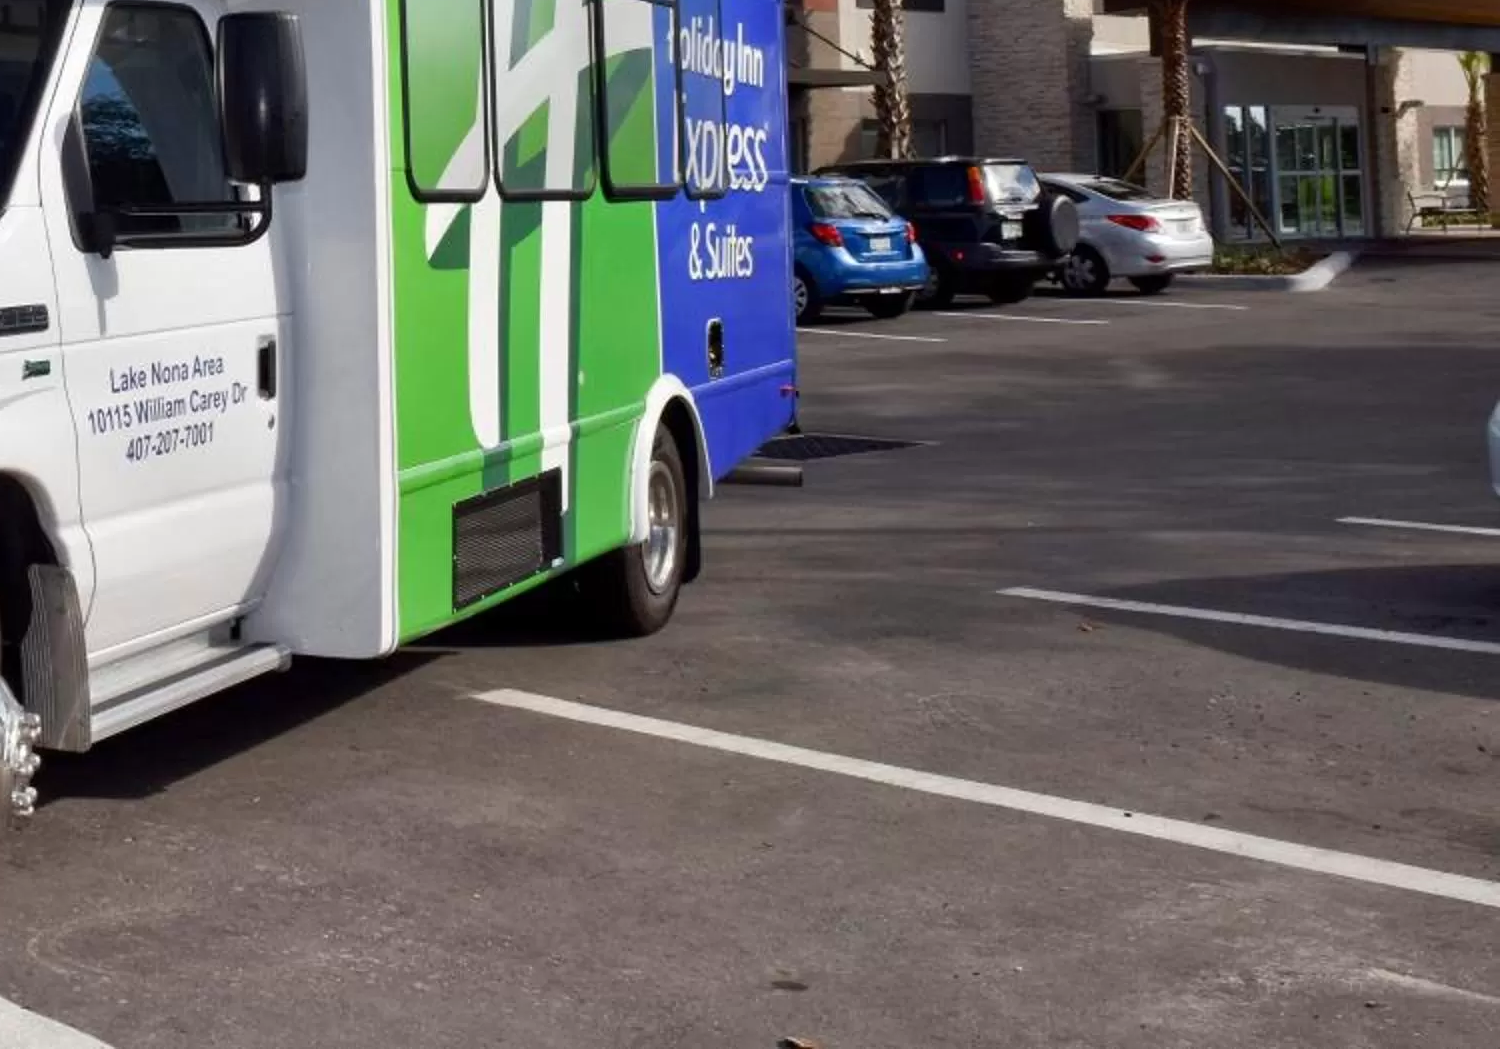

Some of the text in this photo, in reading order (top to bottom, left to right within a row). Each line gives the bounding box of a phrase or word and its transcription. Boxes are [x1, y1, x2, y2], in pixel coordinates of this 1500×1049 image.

[736, 22, 764, 88] Inn
[688, 222, 754, 280] & Suites
[110, 355, 224, 393] Lake Nona Area
[88, 382, 248, 435] 10115 William Carey Dr
[126, 421, 214, 463] 407-207-7001
